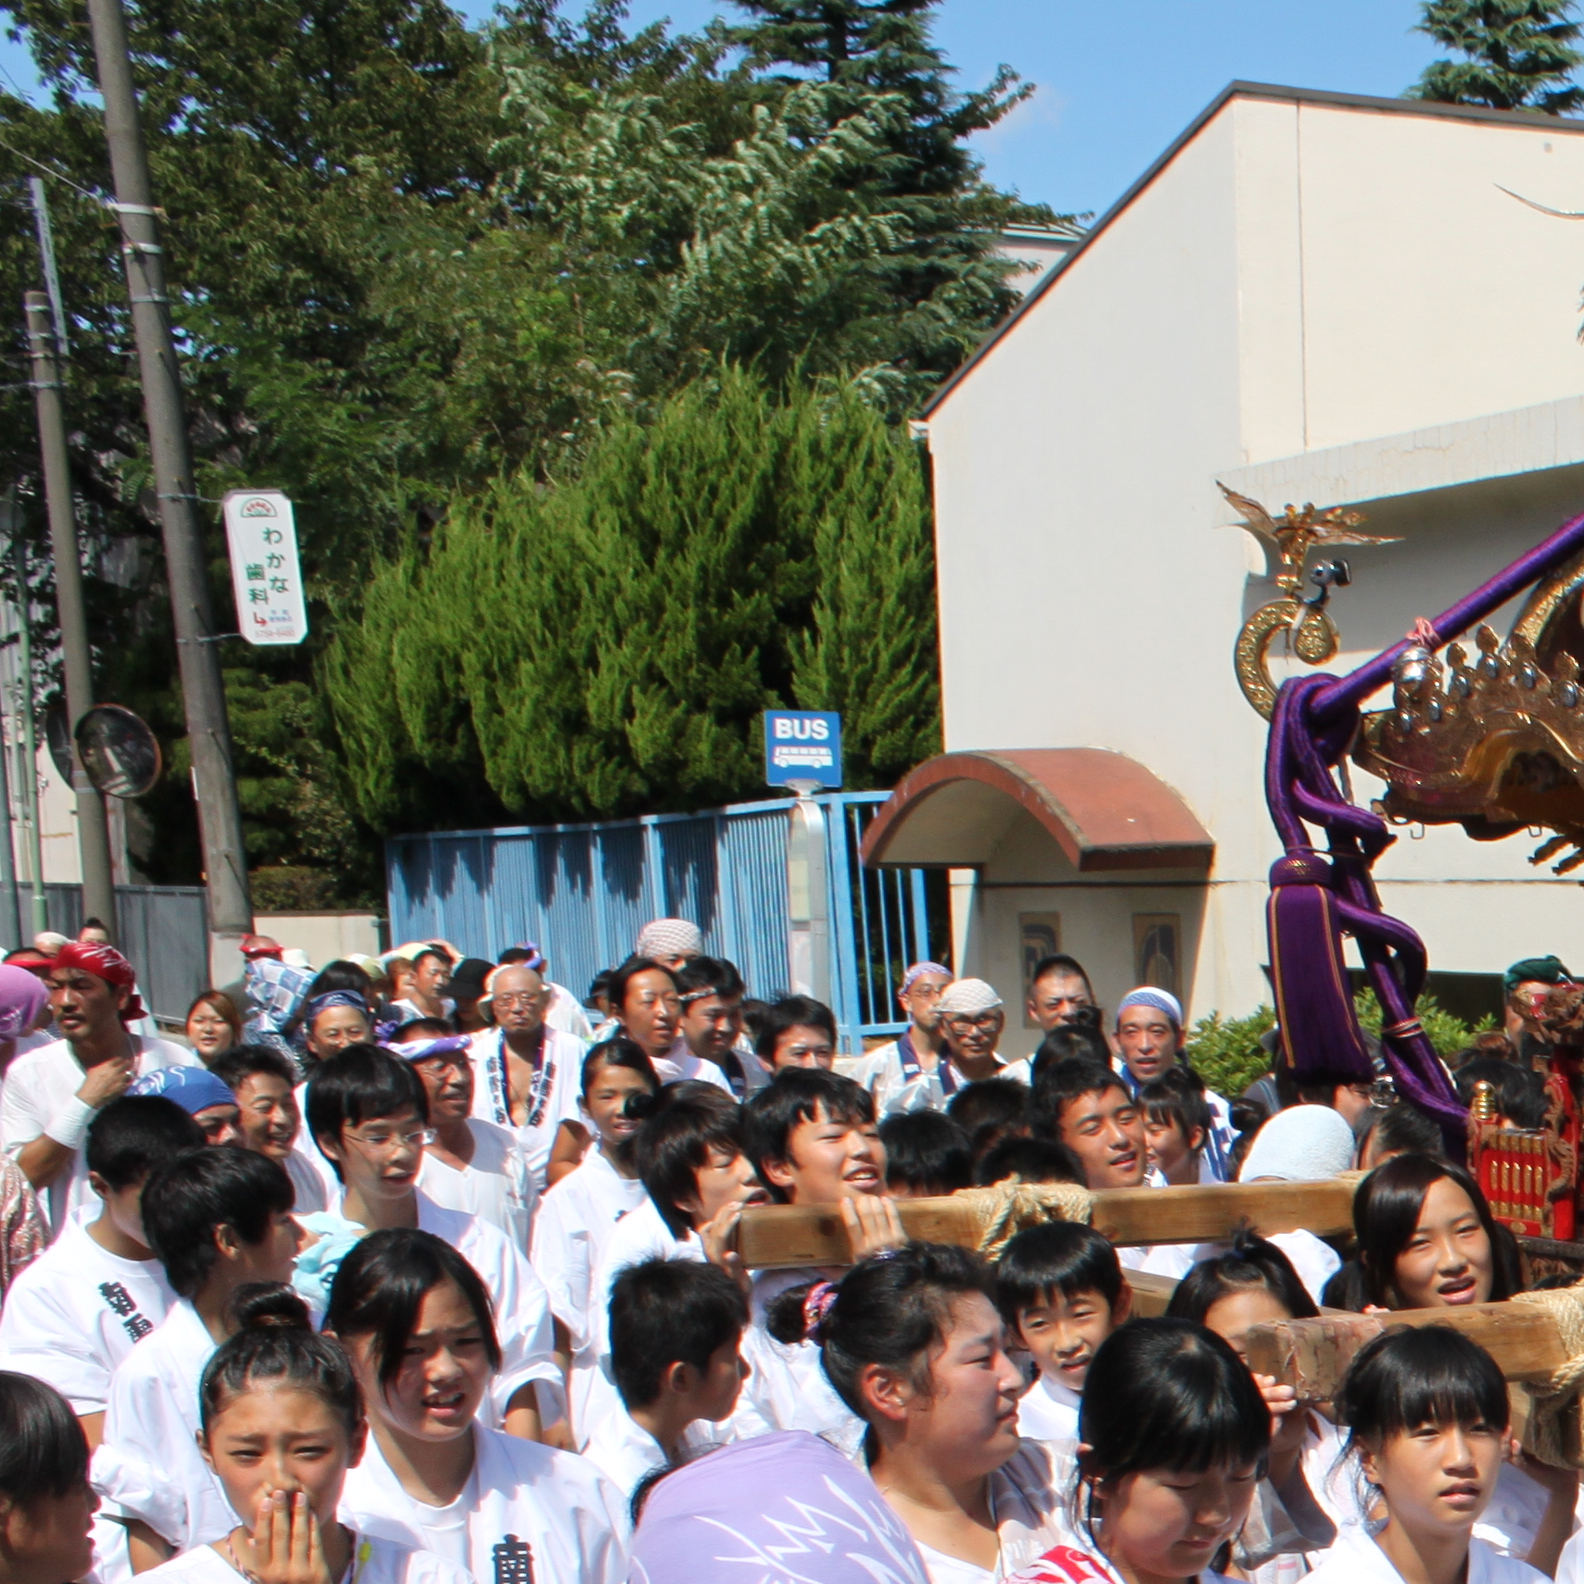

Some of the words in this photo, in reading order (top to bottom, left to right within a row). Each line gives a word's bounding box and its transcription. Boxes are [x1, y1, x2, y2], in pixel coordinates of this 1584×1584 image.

[262, 527, 290, 593] わかな
[245, 563, 269, 605] 歯科
[773, 717, 830, 740] BUS
